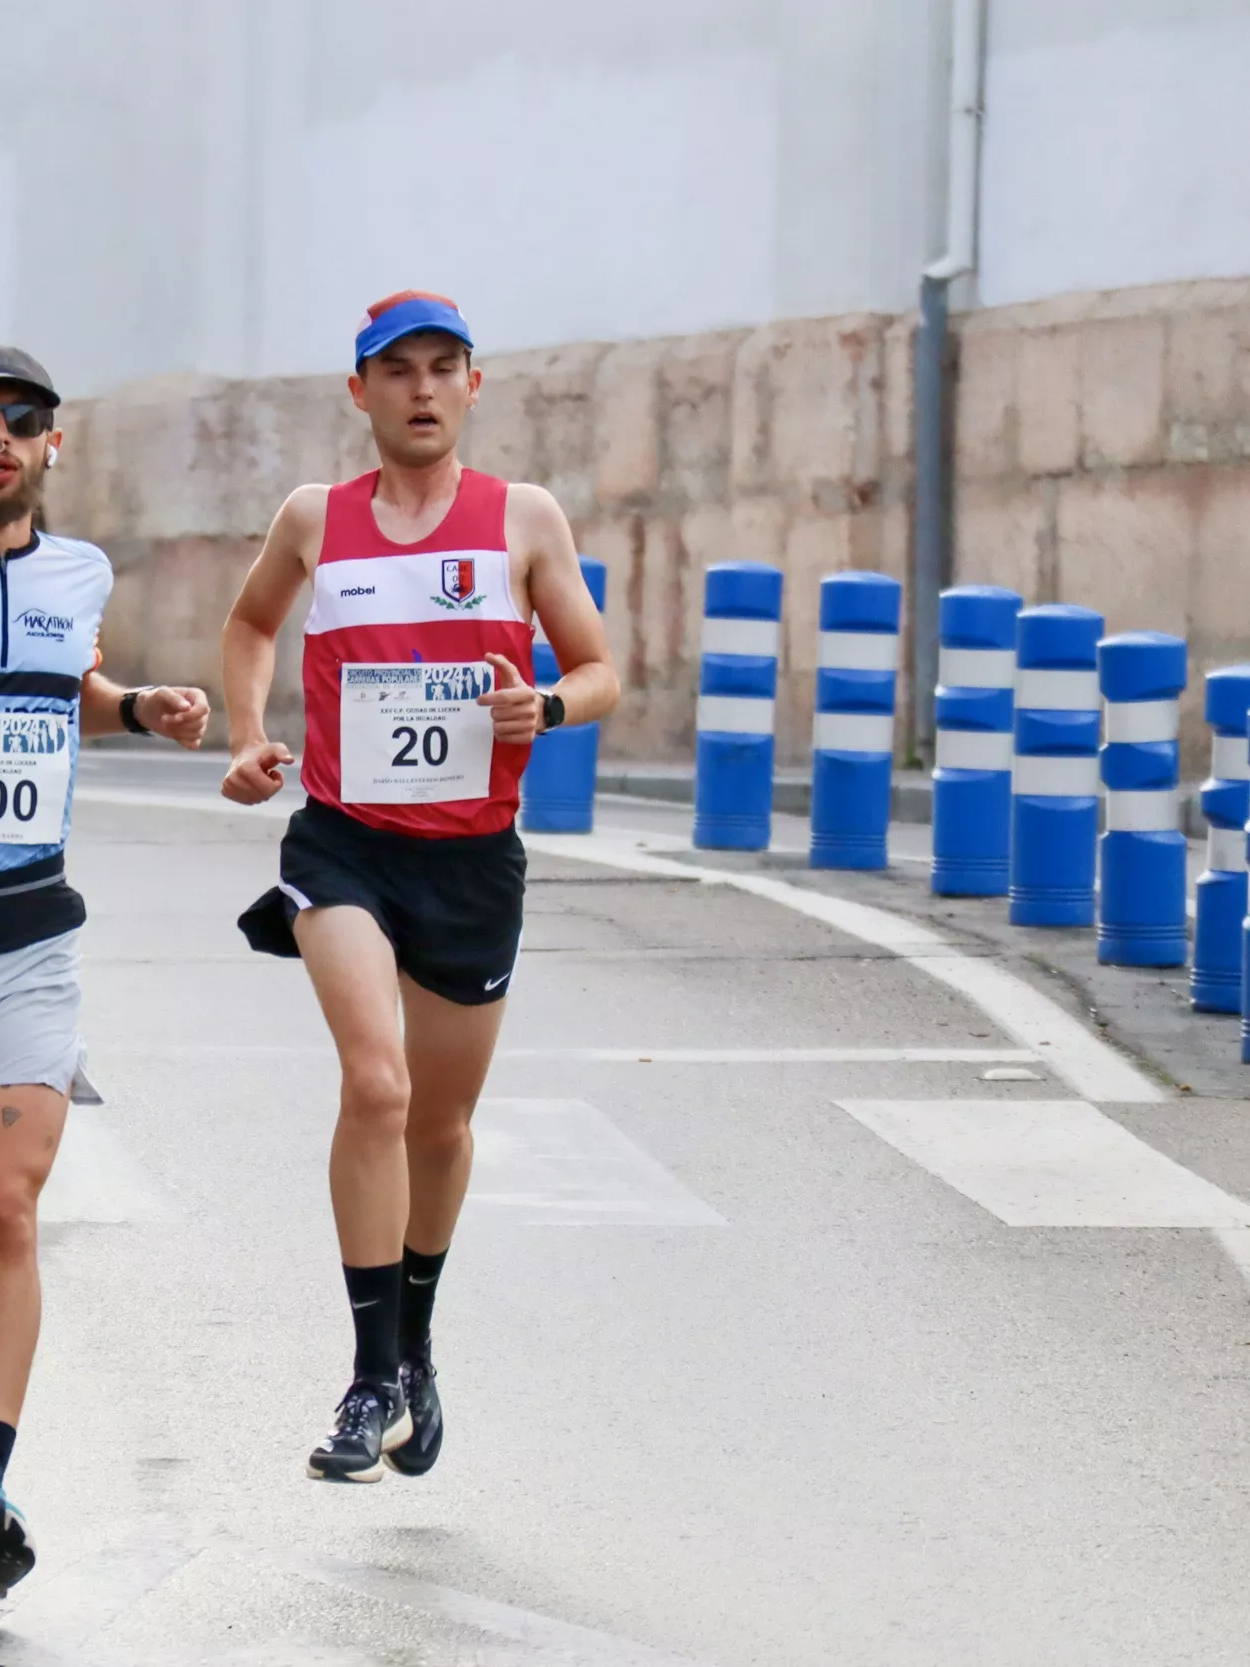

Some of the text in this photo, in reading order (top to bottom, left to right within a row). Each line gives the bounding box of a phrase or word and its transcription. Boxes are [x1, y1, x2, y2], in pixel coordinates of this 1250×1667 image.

[340, 586, 375, 597] mobel
[24, 615, 73, 632] MARATHON
[424, 668, 463, 683] 2024
[2, 719, 40, 735] 2024
[391, 726, 448, 766] 20
